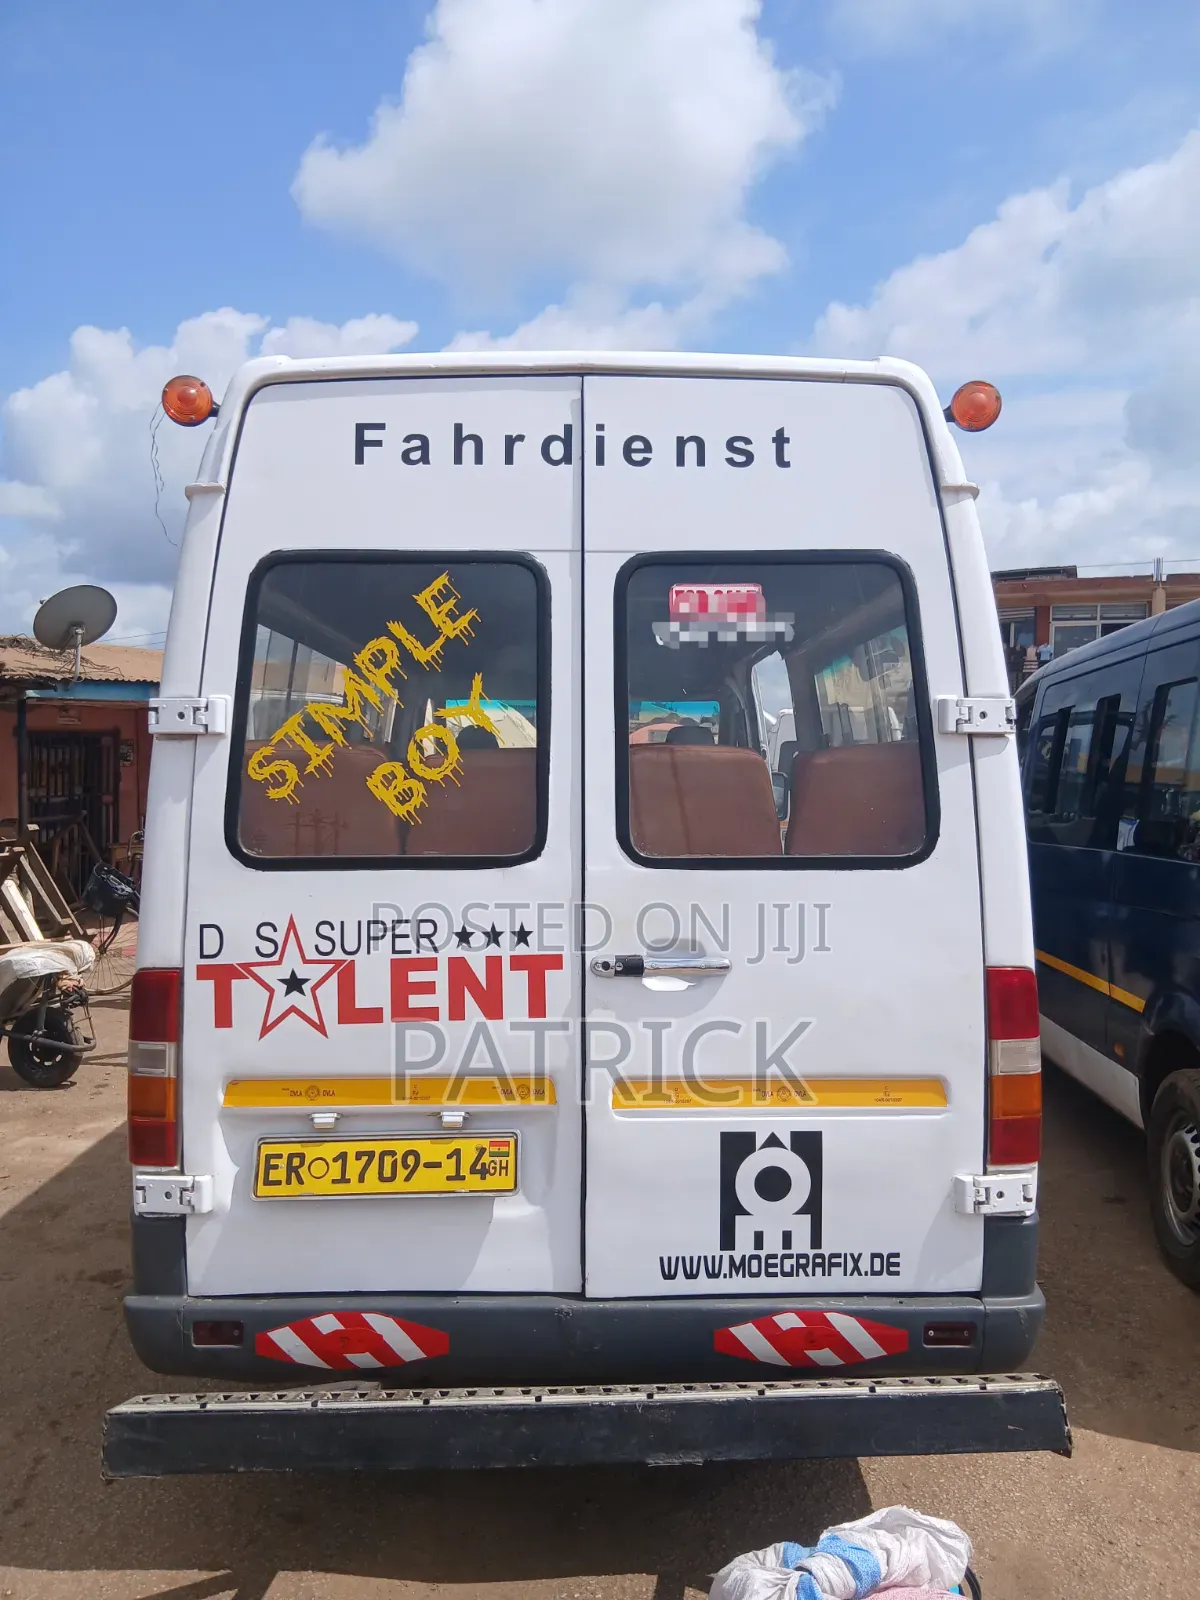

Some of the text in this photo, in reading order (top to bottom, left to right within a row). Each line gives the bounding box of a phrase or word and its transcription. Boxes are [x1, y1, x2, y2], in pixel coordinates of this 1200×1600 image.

[354, 422, 791, 468] Fahrdienst
[248, 570, 481, 805] SIMPLE
[366, 672, 505, 825] BOY
[314, 919, 439, 956] SUPER
[488, 1159, 509, 1177] GH
[659, 1252, 900, 1280] WWW.MOEGRAFIX.DE
